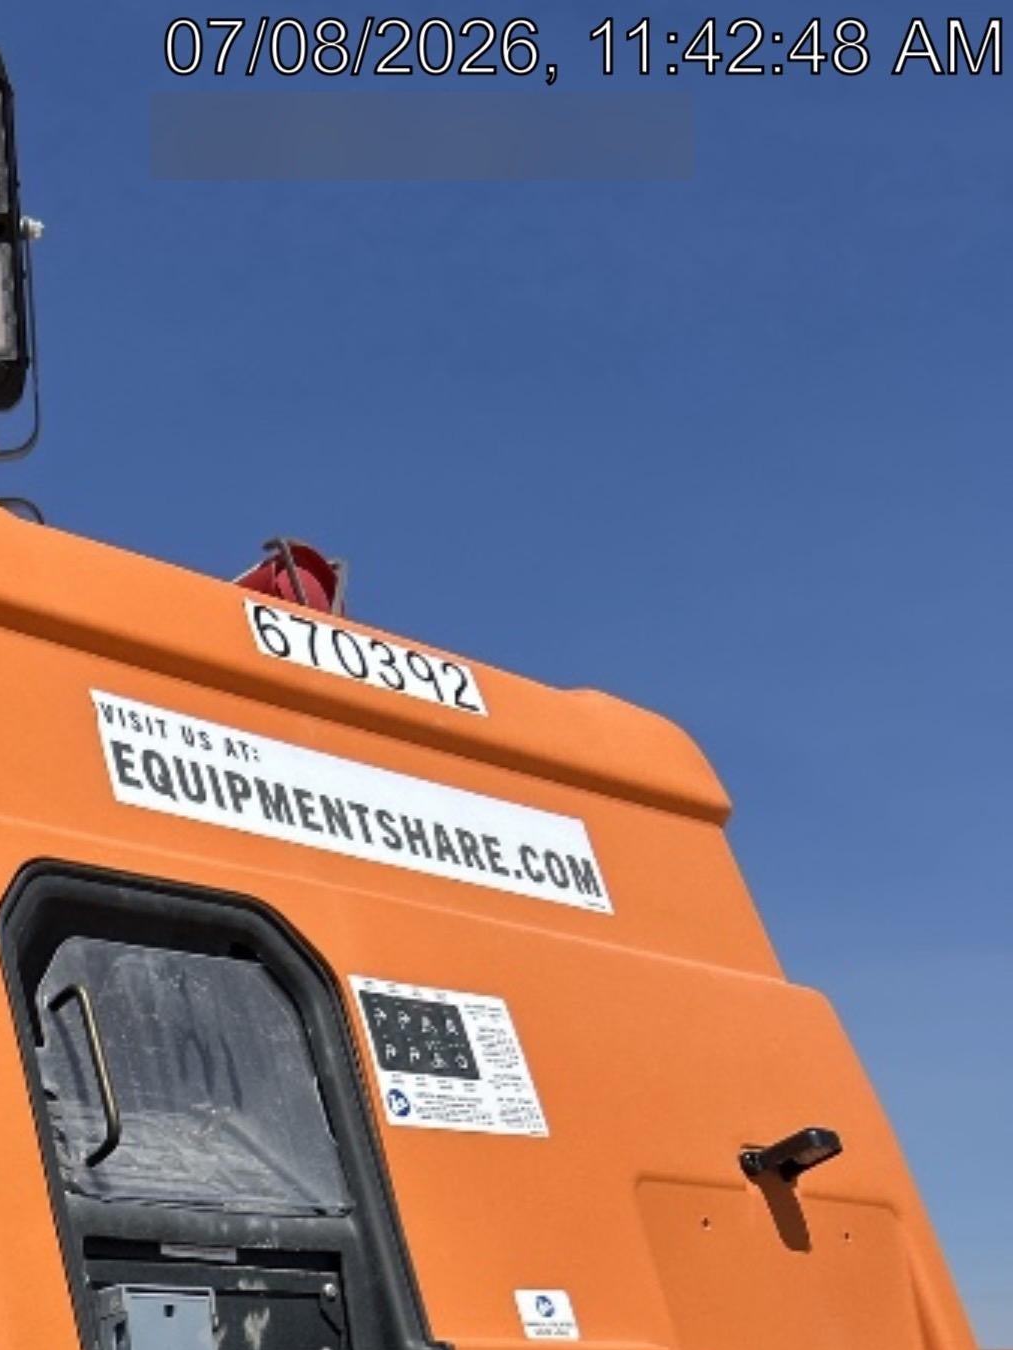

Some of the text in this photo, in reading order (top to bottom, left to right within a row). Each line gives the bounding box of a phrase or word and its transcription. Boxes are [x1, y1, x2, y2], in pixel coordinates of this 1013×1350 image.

[253, 606, 480, 711] 670392
[99, 702, 261, 763] VISIT US AT:
[110, 740, 603, 897] EQUIPMENTSHARE.COM
